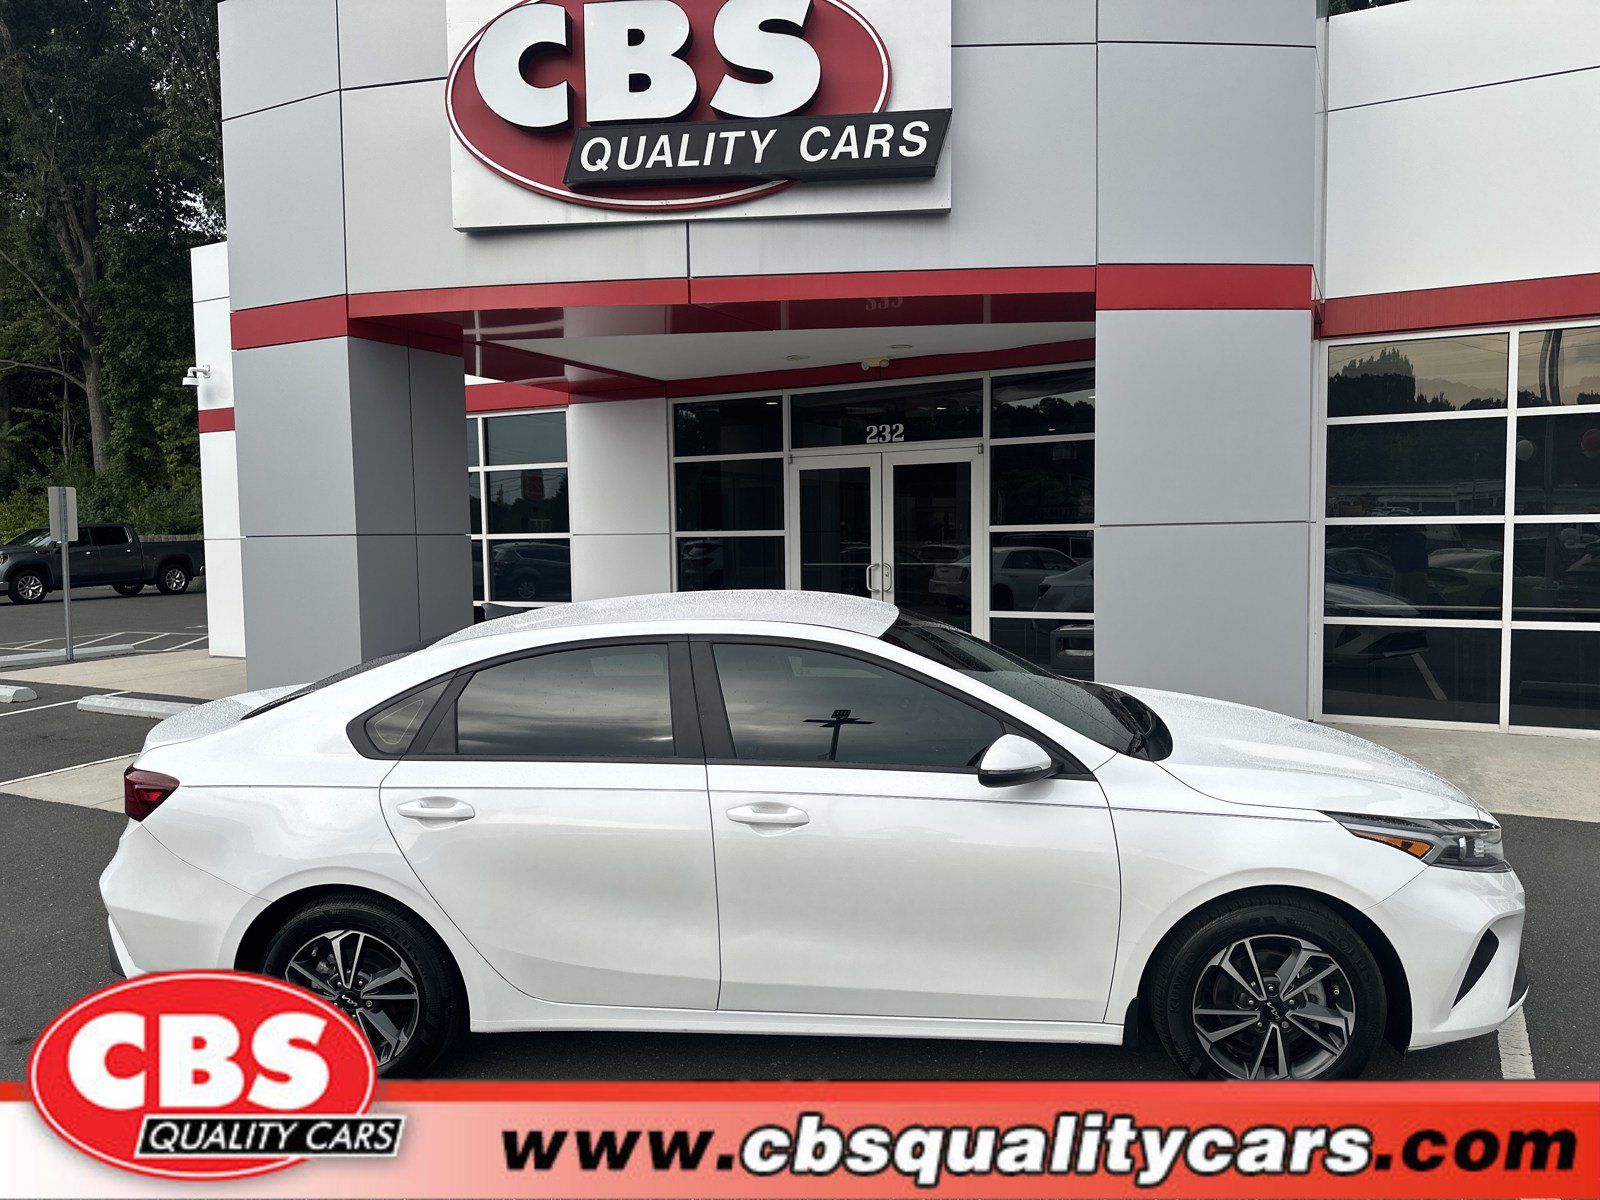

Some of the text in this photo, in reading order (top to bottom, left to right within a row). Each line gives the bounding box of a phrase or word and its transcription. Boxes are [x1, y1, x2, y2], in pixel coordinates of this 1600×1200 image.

[473, 0, 822, 129] CBS
[579, 120, 931, 172] QUALITY CARS
[866, 423, 905, 444] 232
